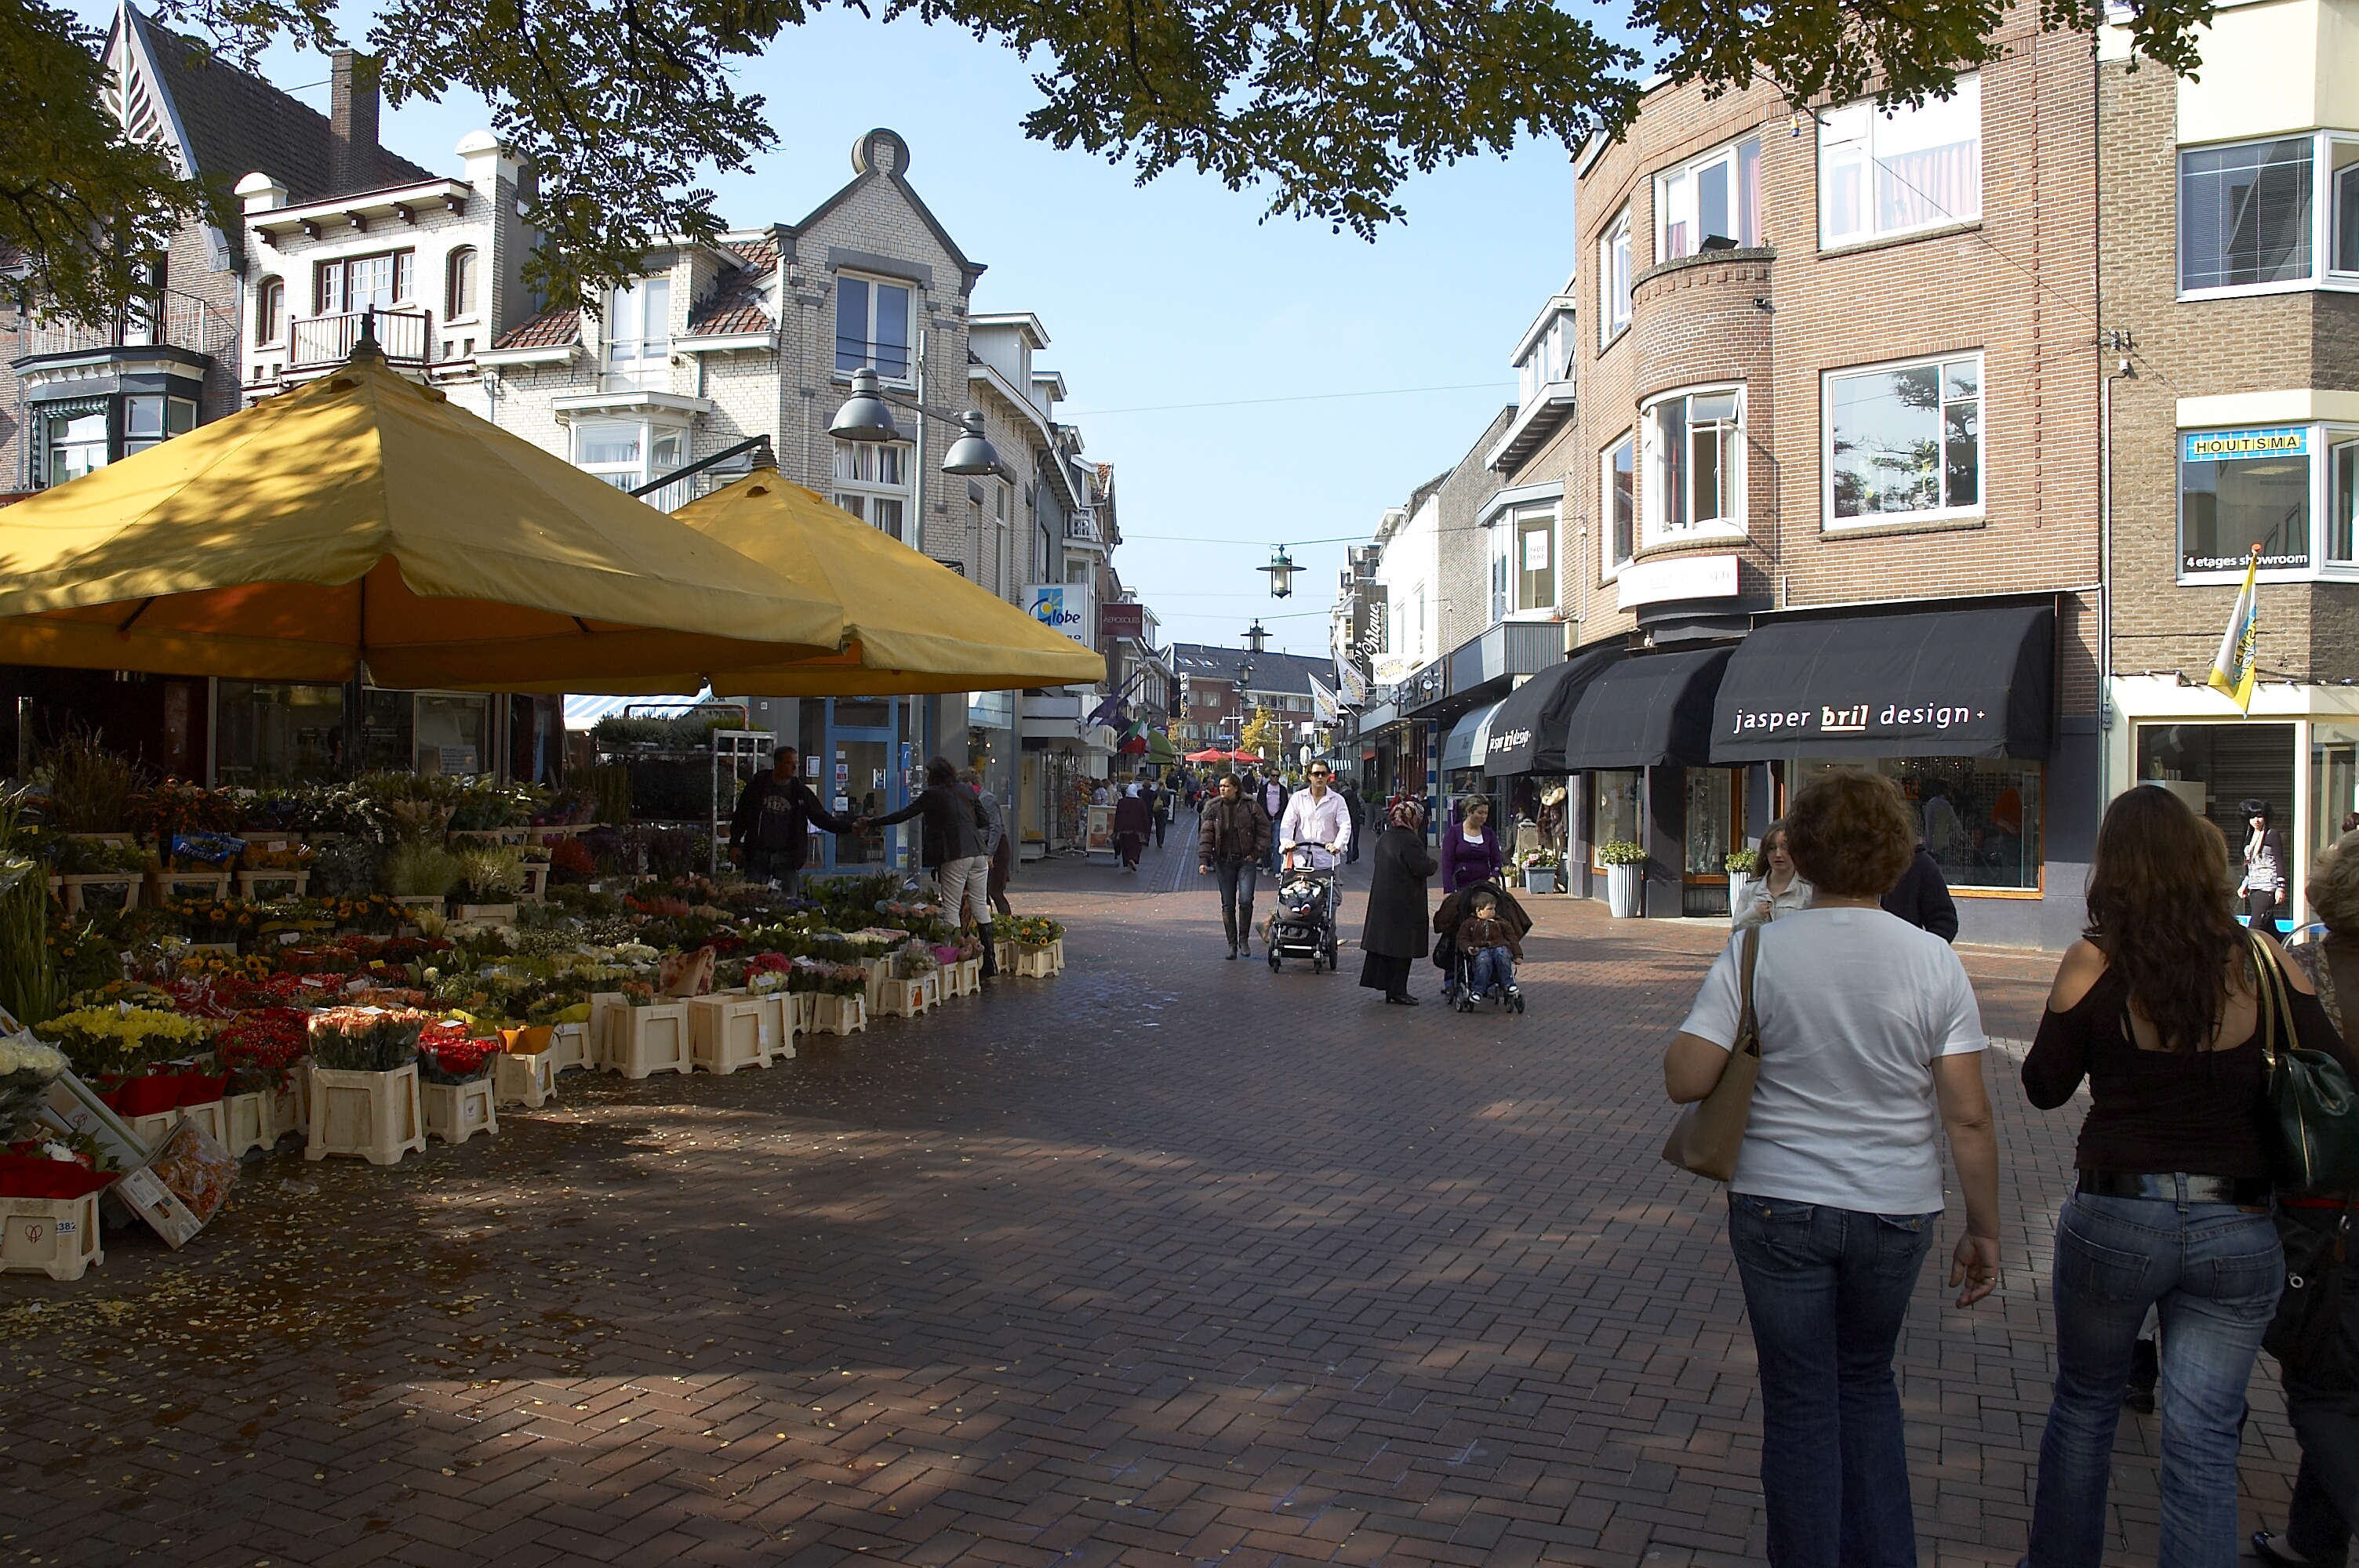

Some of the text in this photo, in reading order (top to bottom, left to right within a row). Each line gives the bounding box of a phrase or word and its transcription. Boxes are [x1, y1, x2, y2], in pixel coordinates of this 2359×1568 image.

[2197, 436, 2297, 453] HOUTSMA
[2186, 557, 2195, 567] 4
[2196, 557, 2237, 569] etages
[1733, 709, 1811, 734] jasper
[1820, 704, 1869, 731] bril
[1880, 702, 1969, 729] design
